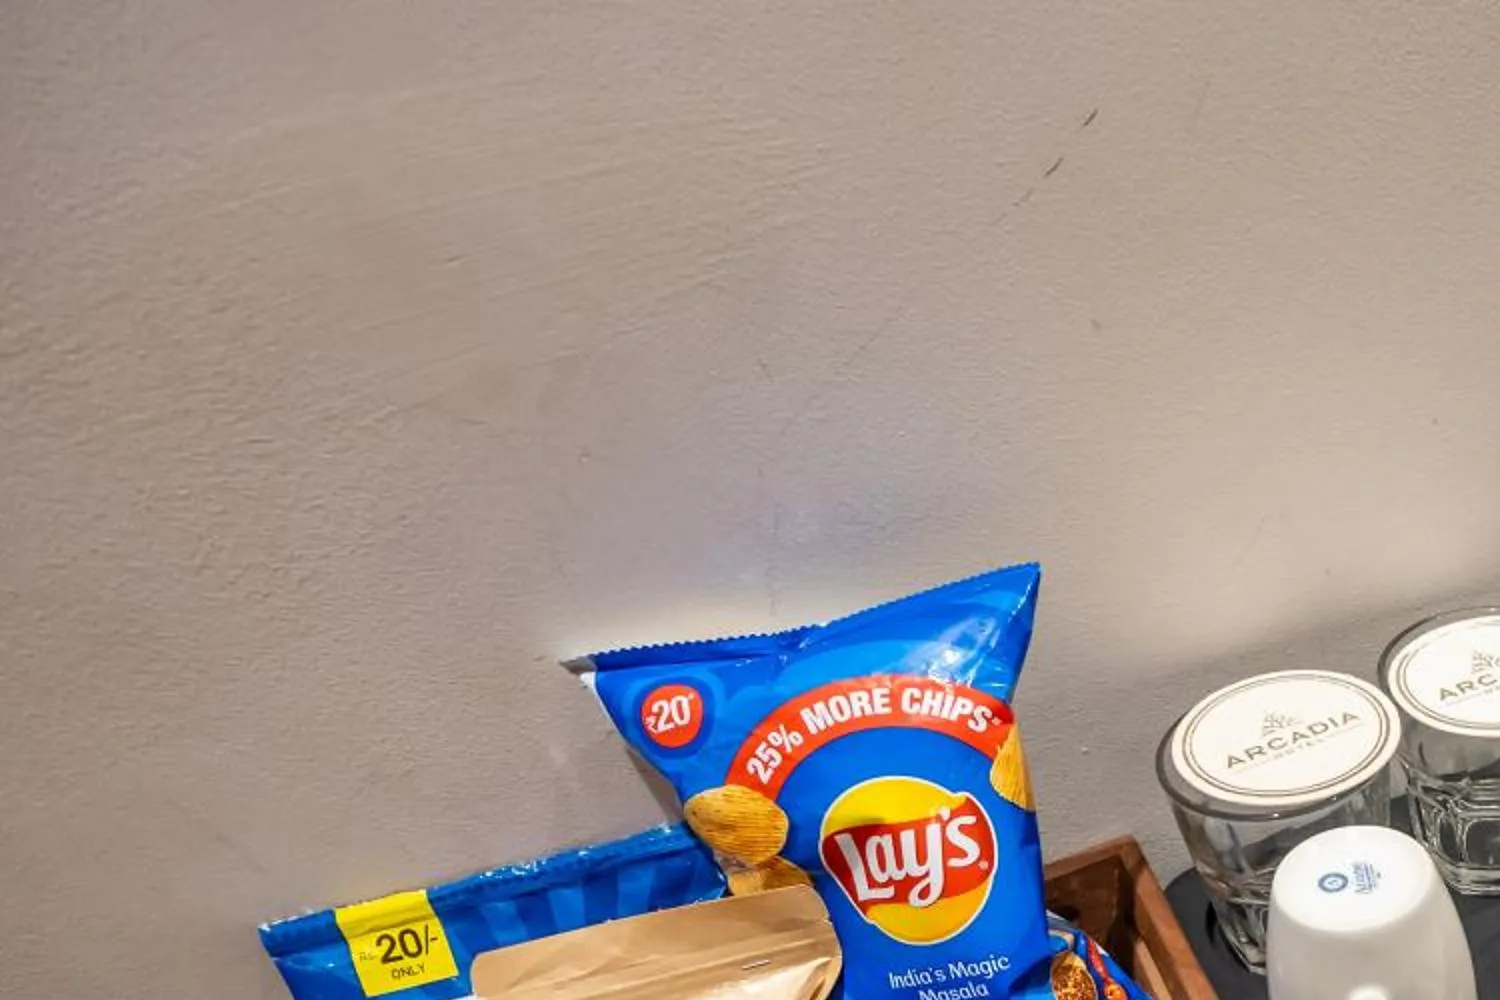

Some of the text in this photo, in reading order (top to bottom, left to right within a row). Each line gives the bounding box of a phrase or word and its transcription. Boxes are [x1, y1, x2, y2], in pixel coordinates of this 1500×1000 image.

[746, 686, 994, 785] 25% MORE CHIPS
[1227, 711, 1359, 769] ARCADIA
[834, 806, 981, 908] Lay's
[391, 962, 425, 980] ONLY
[888, 954, 1010, 990] India's Magic
